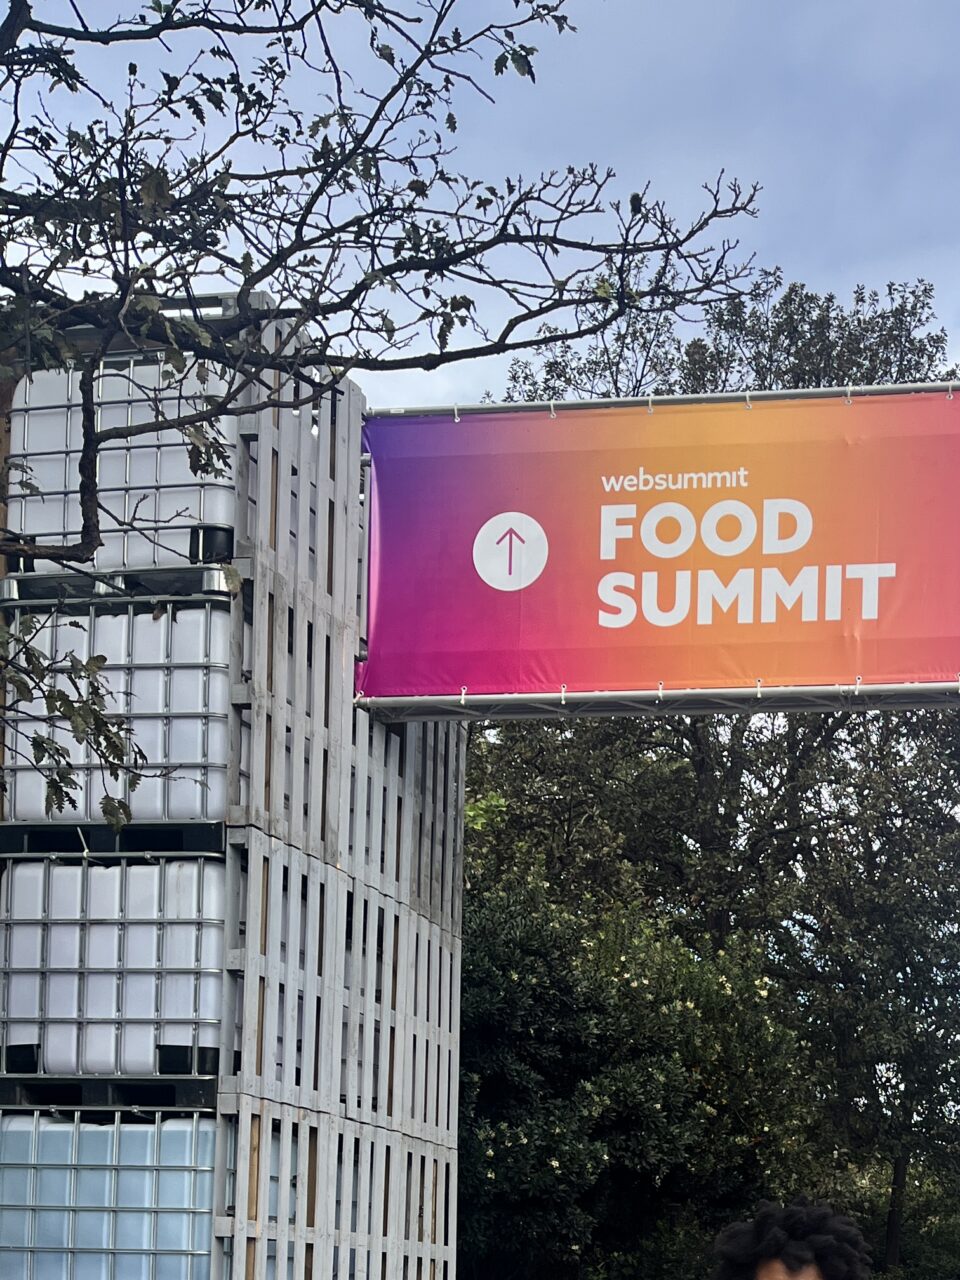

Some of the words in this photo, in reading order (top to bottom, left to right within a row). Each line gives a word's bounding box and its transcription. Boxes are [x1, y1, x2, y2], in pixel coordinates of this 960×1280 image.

[601, 467, 748, 492] websummit
[600, 498, 813, 560] FOOD
[597, 562, 896, 629] SUMMIT
